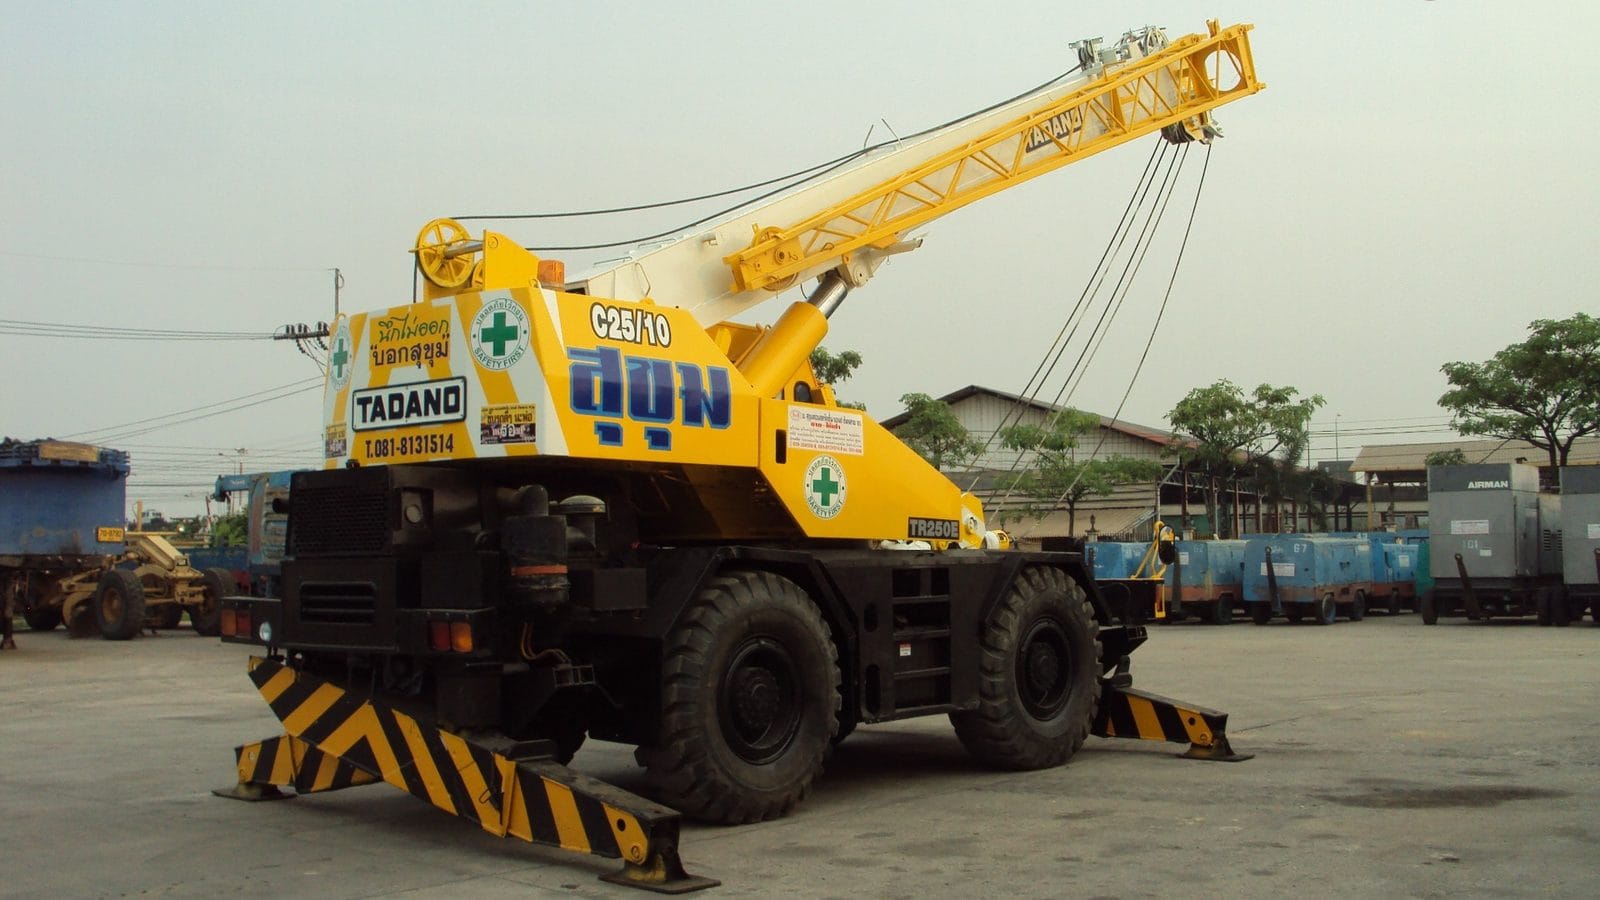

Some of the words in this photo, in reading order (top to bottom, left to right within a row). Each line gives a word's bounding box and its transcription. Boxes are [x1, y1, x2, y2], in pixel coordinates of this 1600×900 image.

[378, 314, 449, 343] นึกไม่ออก
[590, 302, 671, 347] C25/10
[475, 347, 502, 368] SAFETY
[503, 346, 525, 367] FIRST
[356, 385, 461, 423] TADANO
[365, 433, 454, 459] T.081-8131514
[1467, 480, 1509, 490] AIRMAN
[808, 496, 827, 517] SAFETY
[909, 518, 959, 538] TR250E
